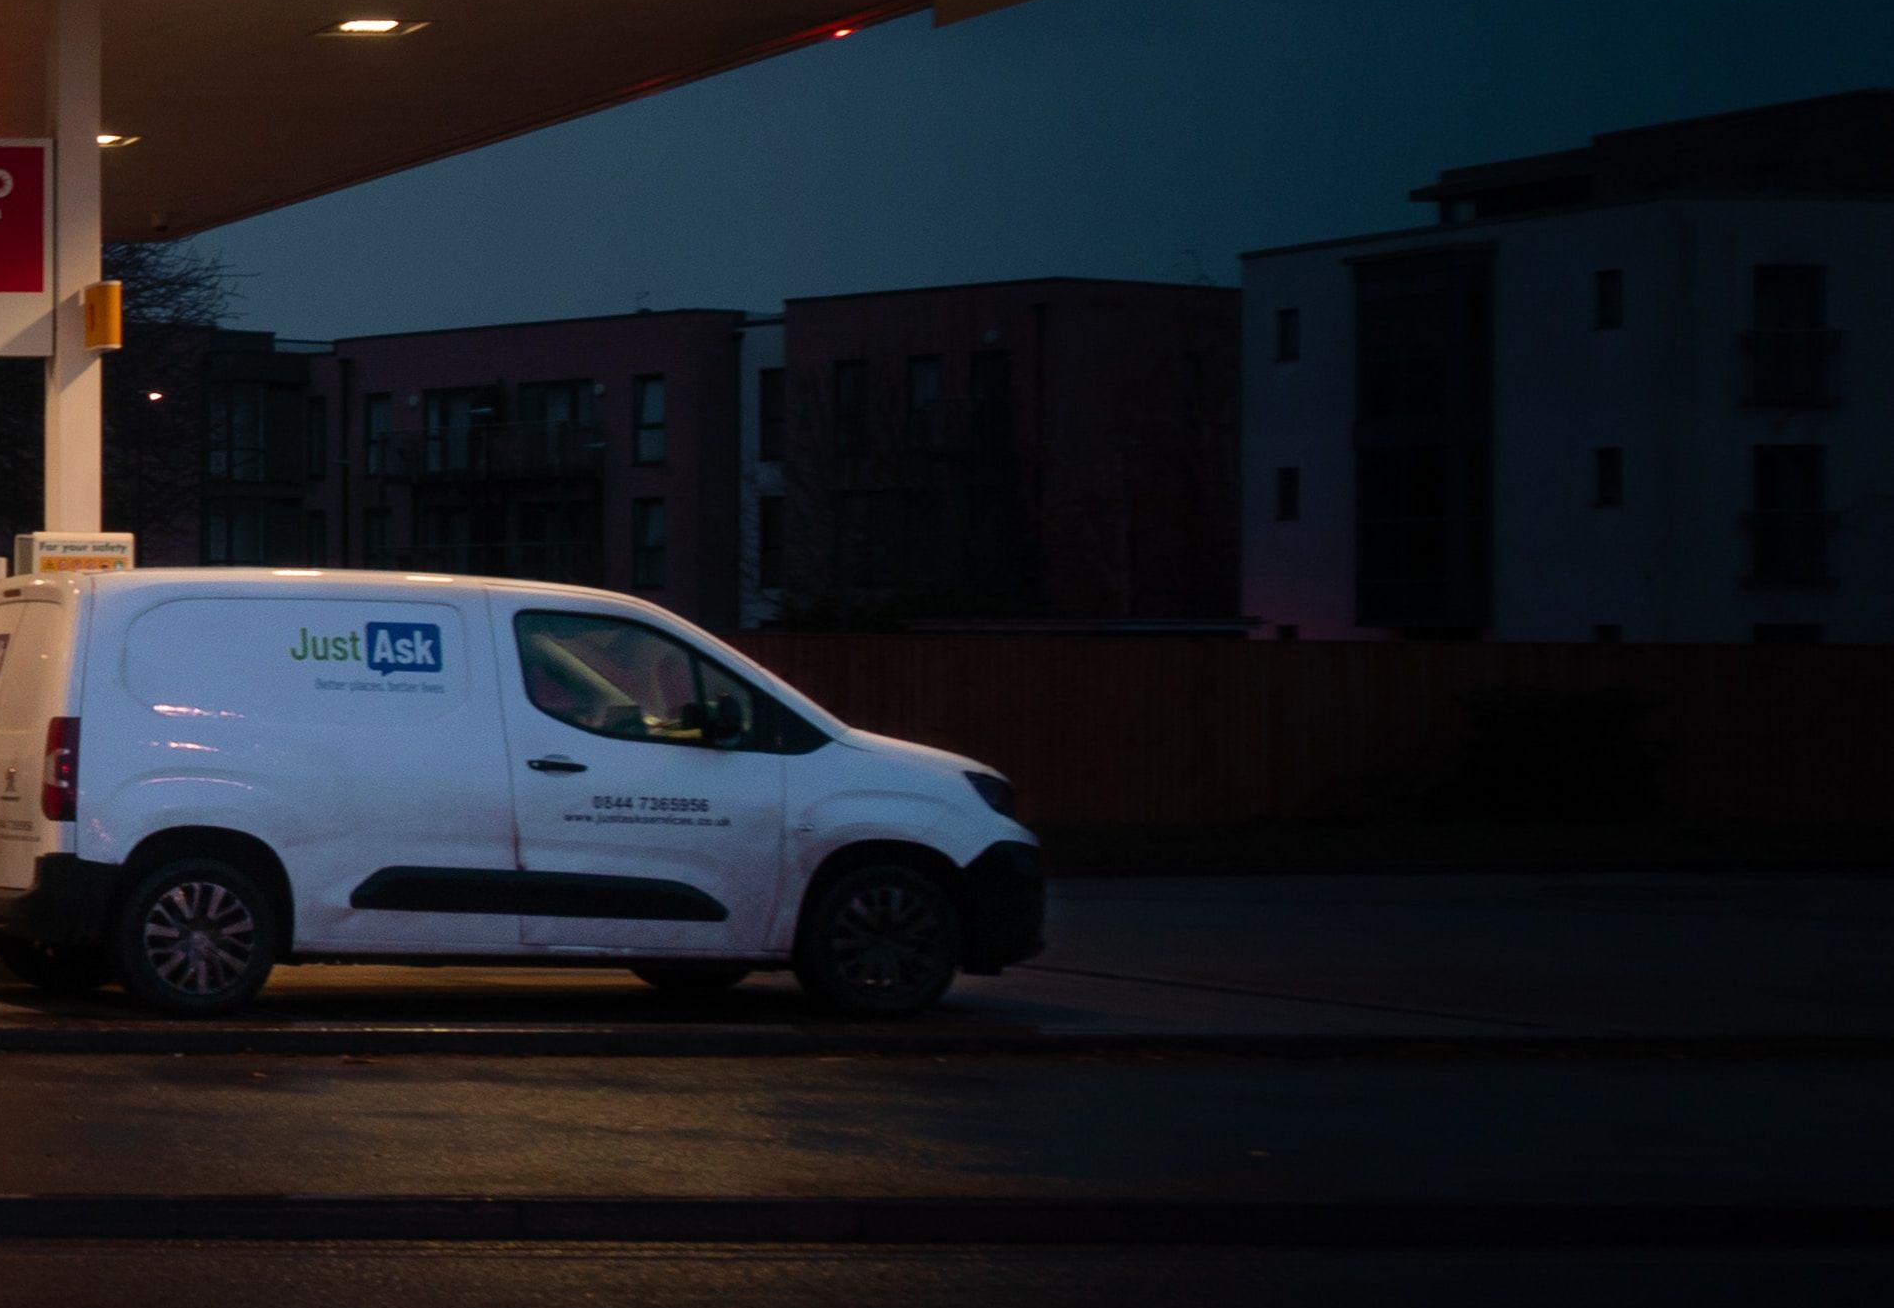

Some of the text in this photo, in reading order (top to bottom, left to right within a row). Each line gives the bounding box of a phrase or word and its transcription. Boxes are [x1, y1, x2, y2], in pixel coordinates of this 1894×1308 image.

[39, 542, 128, 553] For your safety
[290, 627, 436, 665] Just Ask
